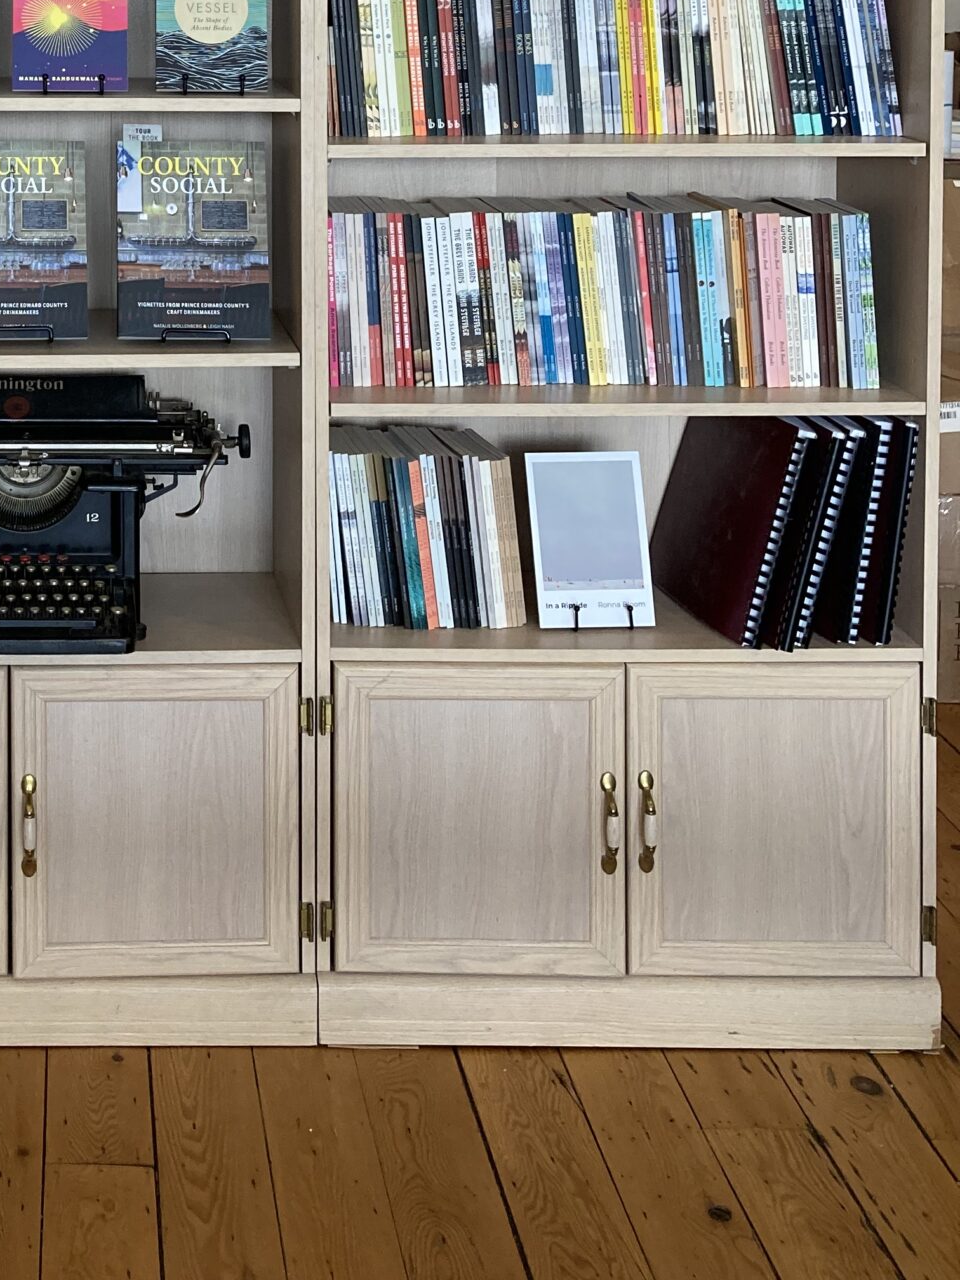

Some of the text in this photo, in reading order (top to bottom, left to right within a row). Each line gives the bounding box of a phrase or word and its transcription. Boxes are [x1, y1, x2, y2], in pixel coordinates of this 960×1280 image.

[186, 2, 237, 13] VESSEL
[514, 33, 523, 55] BONES
[524, 33, 532, 55] BONES
[137, 156, 245, 175] COUNTY
[150, 176, 233, 194] SOCIAL
[439, 222, 448, 241] JOHN
[441, 244, 450, 276] STEFFLER
[464, 227, 484, 367] THE GREY ISLANDS STEFFLER BRICK
[446, 299, 454, 317] GREY
[448, 320, 456, 351] ISLANDS
[86, 512, 100, 523] 12
